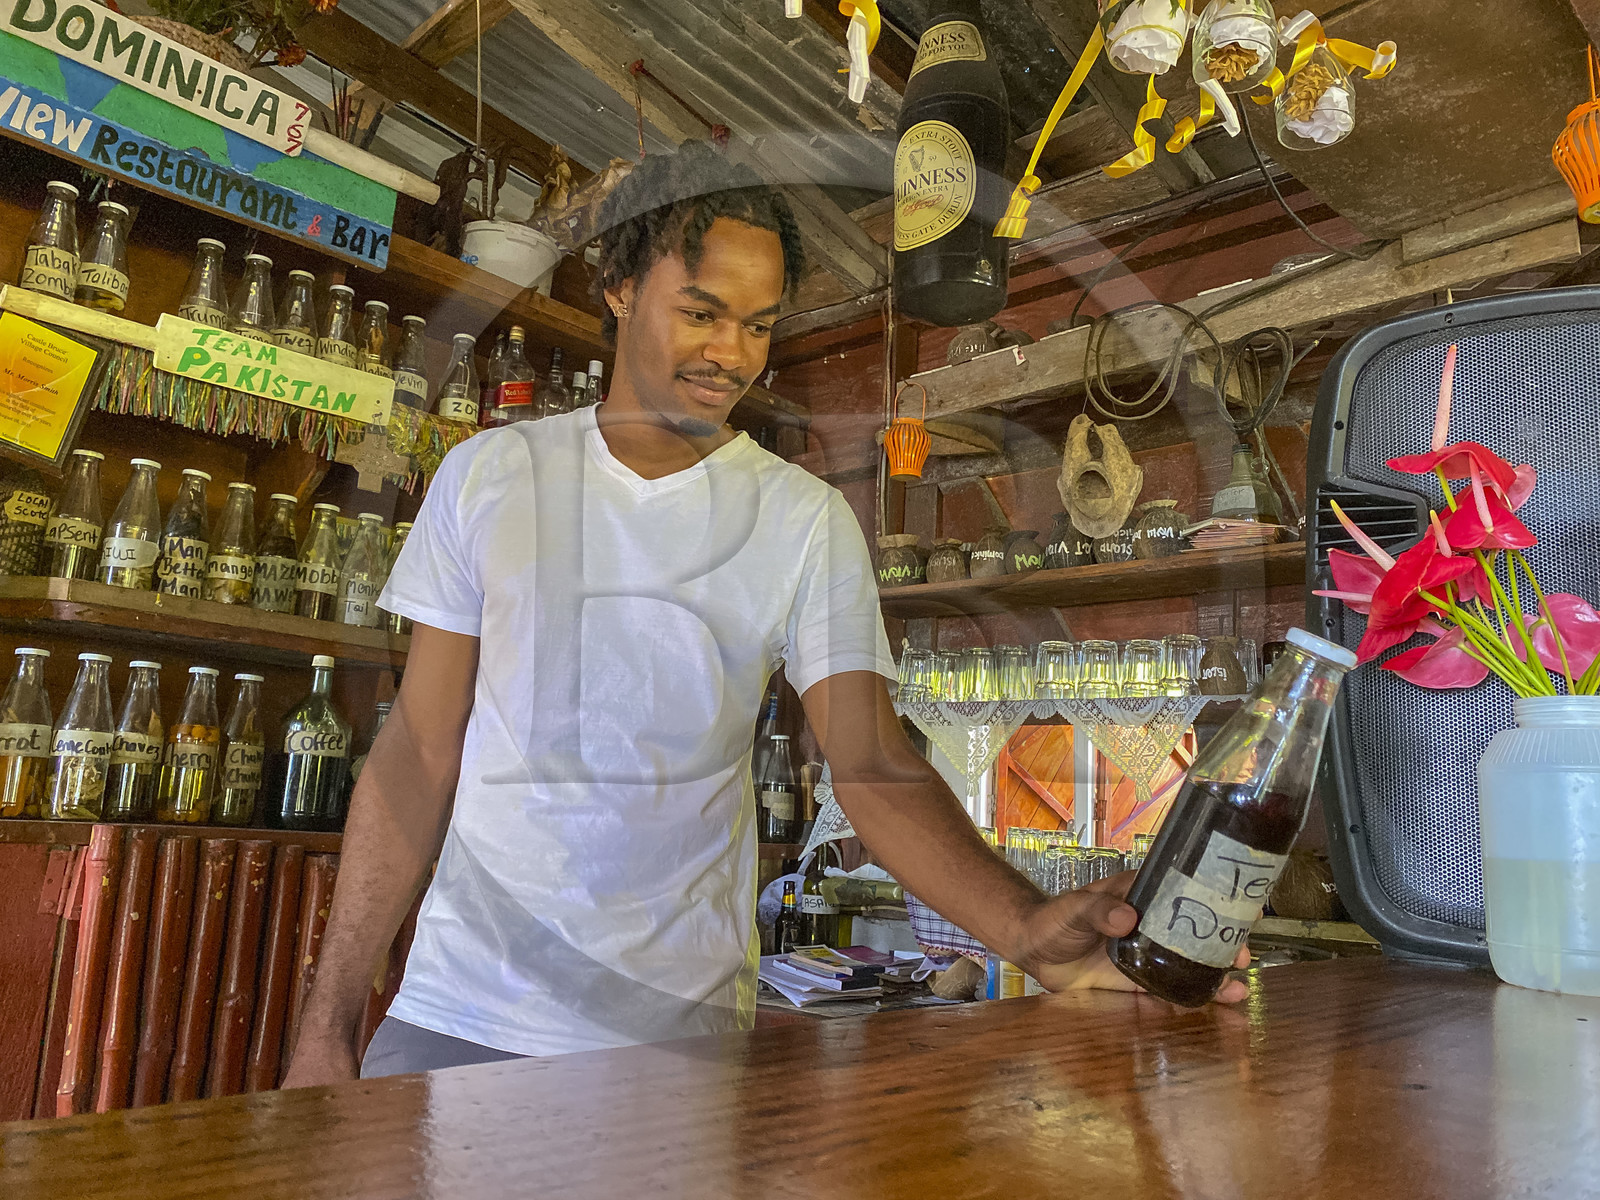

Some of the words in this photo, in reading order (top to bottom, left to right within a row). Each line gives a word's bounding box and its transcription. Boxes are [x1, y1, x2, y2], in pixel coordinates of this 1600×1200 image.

[9, 0, 281, 136] DOMINICA
[307, 214, 322, 237] &
[192, 328, 278, 366] TEAM
[39, 382, 59, 396] Smith
[177, 347, 357, 413] PAKISTAN
[287, 731, 344, 753] Coffee
